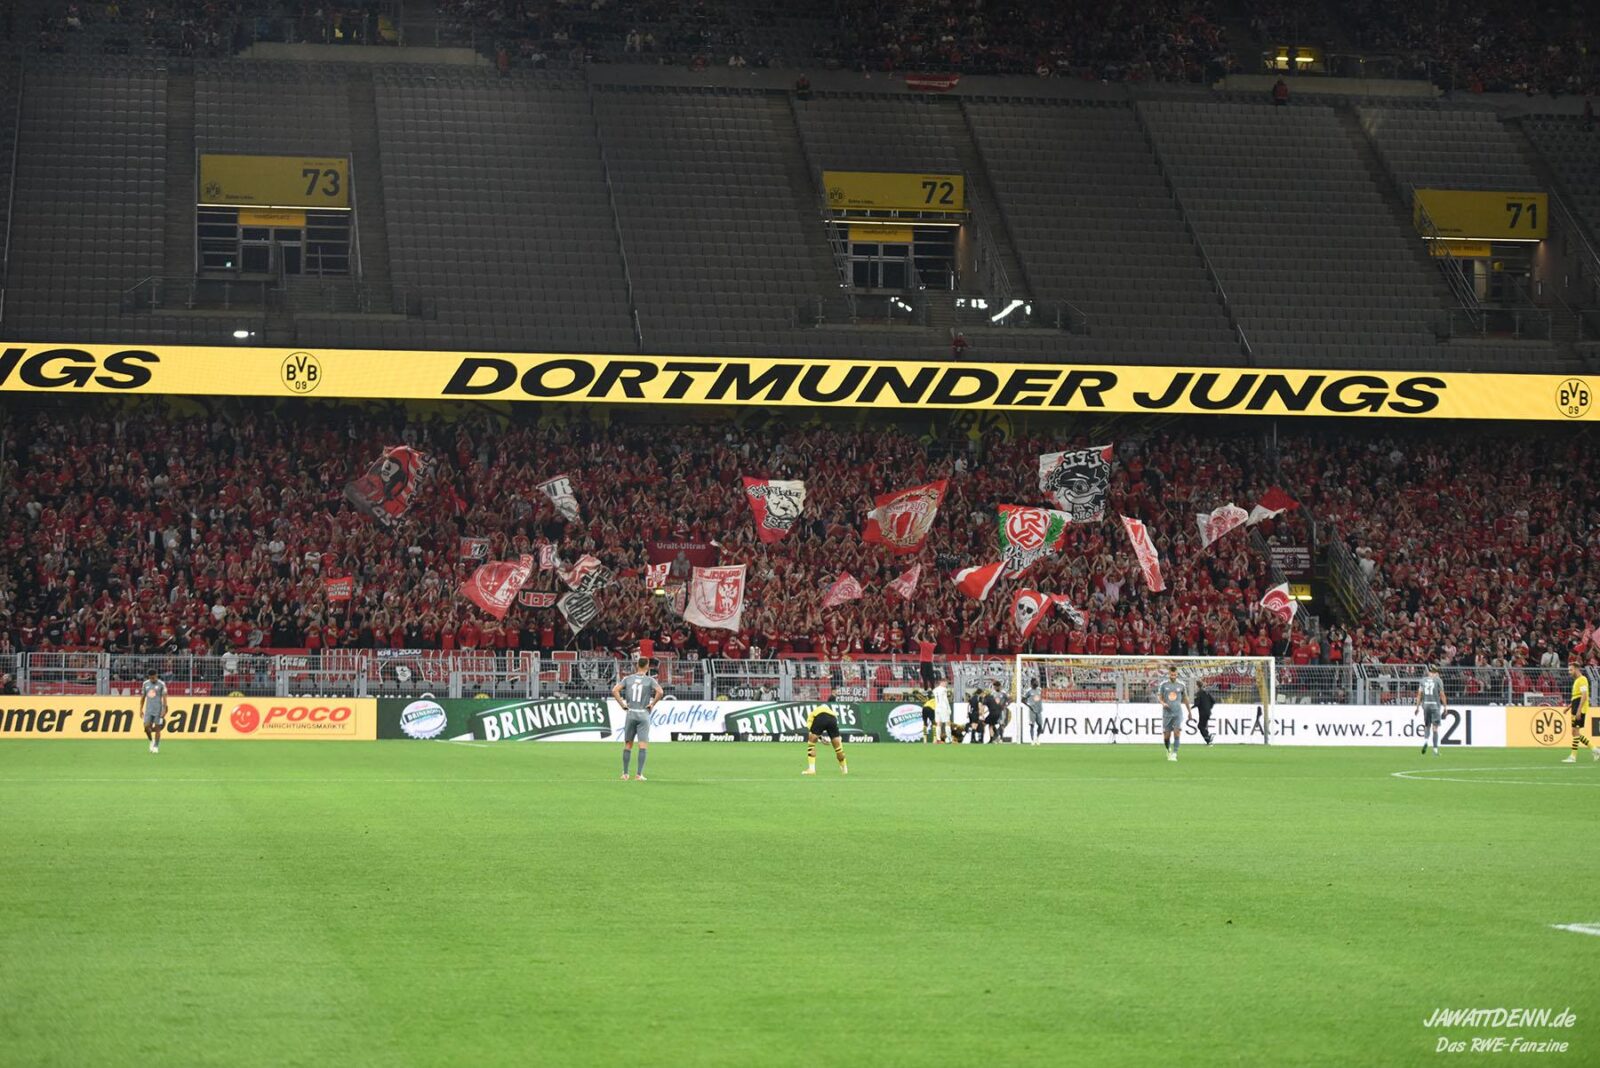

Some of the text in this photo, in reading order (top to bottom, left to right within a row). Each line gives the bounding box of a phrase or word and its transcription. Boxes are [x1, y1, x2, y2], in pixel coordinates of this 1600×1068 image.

[303, 169, 340, 196] 73
[922, 181, 954, 204] 72
[1507, 203, 1537, 229] 71
[286, 356, 318, 381] BVB
[441, 357, 1447, 414] DORTMUNDER JUNGS
[1560, 382, 1589, 407] BVB
[656, 542, 706, 550] Uralt-Ultras
[631, 683, 644, 702] 11
[1424, 682, 1435, 696] 27
[81, 709, 134, 732] am
[263, 706, 352, 724] POCO
[737, 704, 857, 734] BRINKHFF's
[1535, 711, 1563, 735] BVB
[678, 733, 702, 741] bwin
[710, 733, 734, 741] bwin
[1041, 718, 1078, 735] WIR
[1316, 719, 1426, 737] www.21.de
[748, 733, 772, 742] bwin
[780, 733, 804, 742] bwin
[849, 734, 873, 743] bwin
